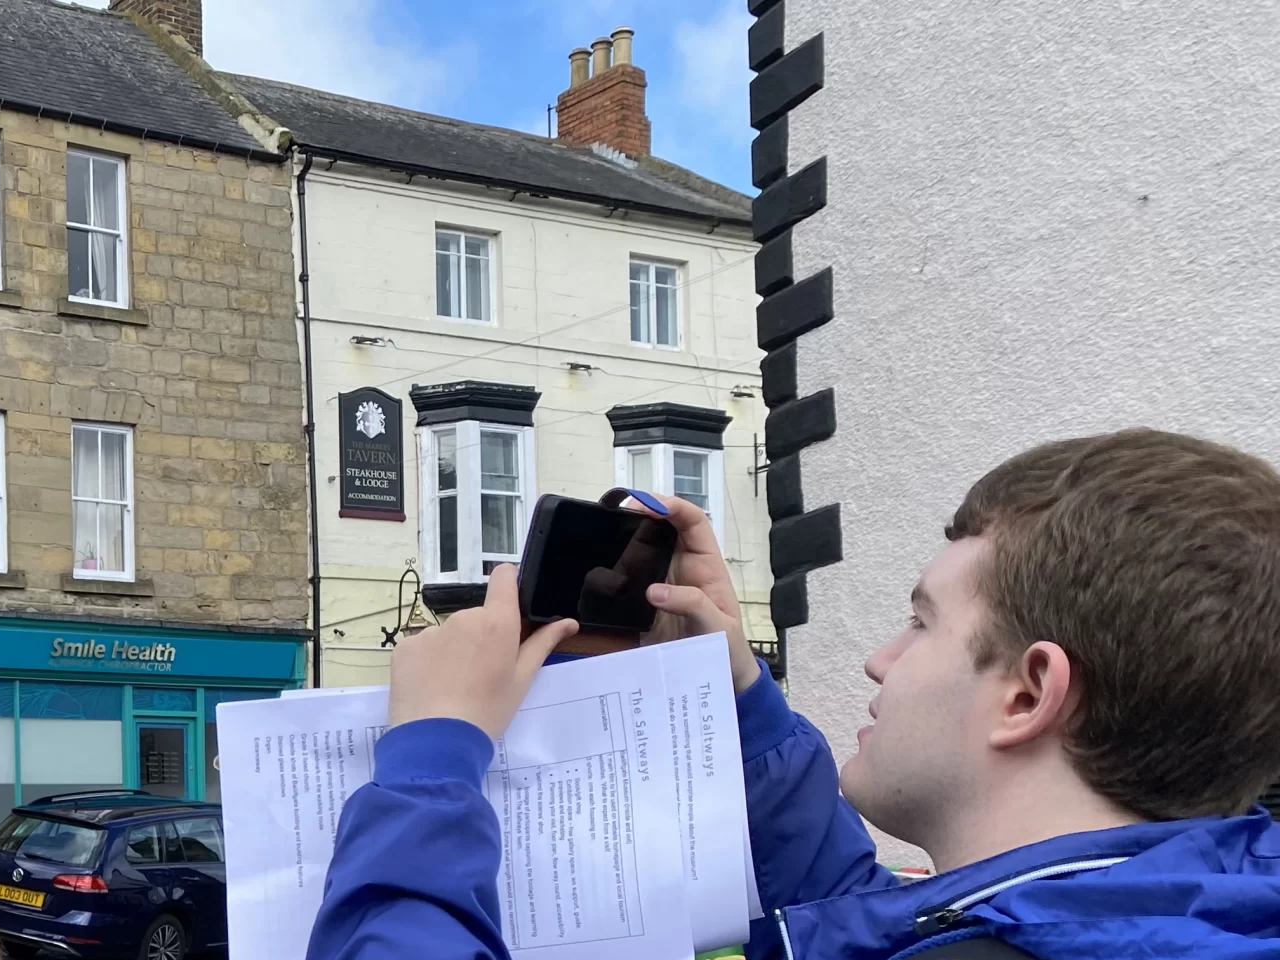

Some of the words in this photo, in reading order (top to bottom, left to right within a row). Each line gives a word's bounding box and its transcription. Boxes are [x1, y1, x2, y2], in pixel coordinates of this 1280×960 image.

[347, 448, 397, 465] TAVERN
[346, 467, 397, 480] STEAKHOUSE
[354, 479, 362, 487] &
[362, 479, 390, 489] LODGE
[347, 492, 397, 502] ACCOMMODATION
[50, 637, 106, 659] Smile
[111, 640, 177, 662] Health
[97, 660, 172, 672] CHIROPRACTOR
[631, 687, 643, 714] The
[699, 681, 711, 708] The
[599, 695, 607, 731] Deliverables
[264, 736, 272, 754] Organ
[636, 720, 649, 782] Saltways
[701, 714, 716, 777] Saltways
